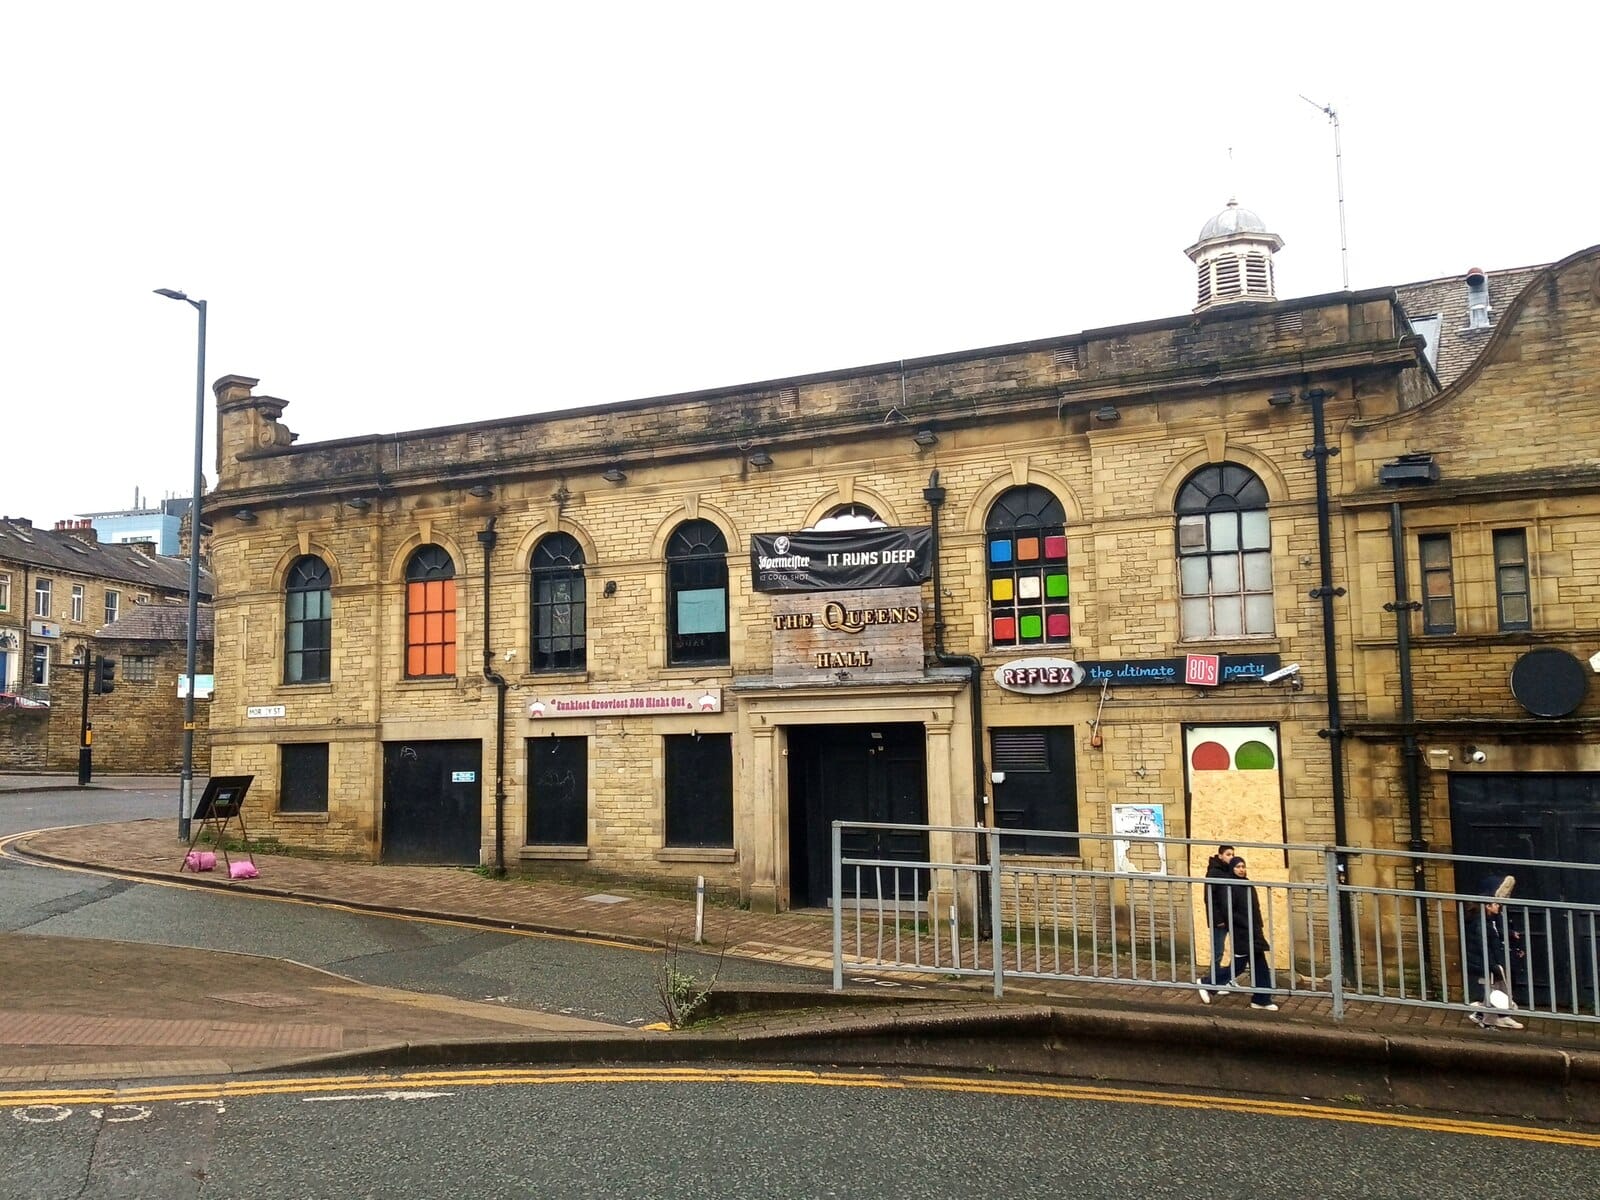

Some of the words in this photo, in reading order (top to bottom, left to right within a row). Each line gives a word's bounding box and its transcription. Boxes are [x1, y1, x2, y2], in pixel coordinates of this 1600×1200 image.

[827, 553, 840, 567] IT
[842, 551, 878, 566] RUNS
[883, 549, 916, 564] DEEP
[790, 573, 809, 581] SHOT
[774, 613, 813, 630] THE
[821, 601, 920, 634] QUEENS
[815, 651, 873, 668] HALL
[1003, 667, 1075, 686] REFLEX
[1089, 665, 1113, 680] the
[1116, 664, 1176, 680] ultimate
[1188, 658, 1216, 683] 80's
[1223, 663, 1265, 680] party
[671, 696, 686, 707] Out
[273, 707, 281, 715] ST
